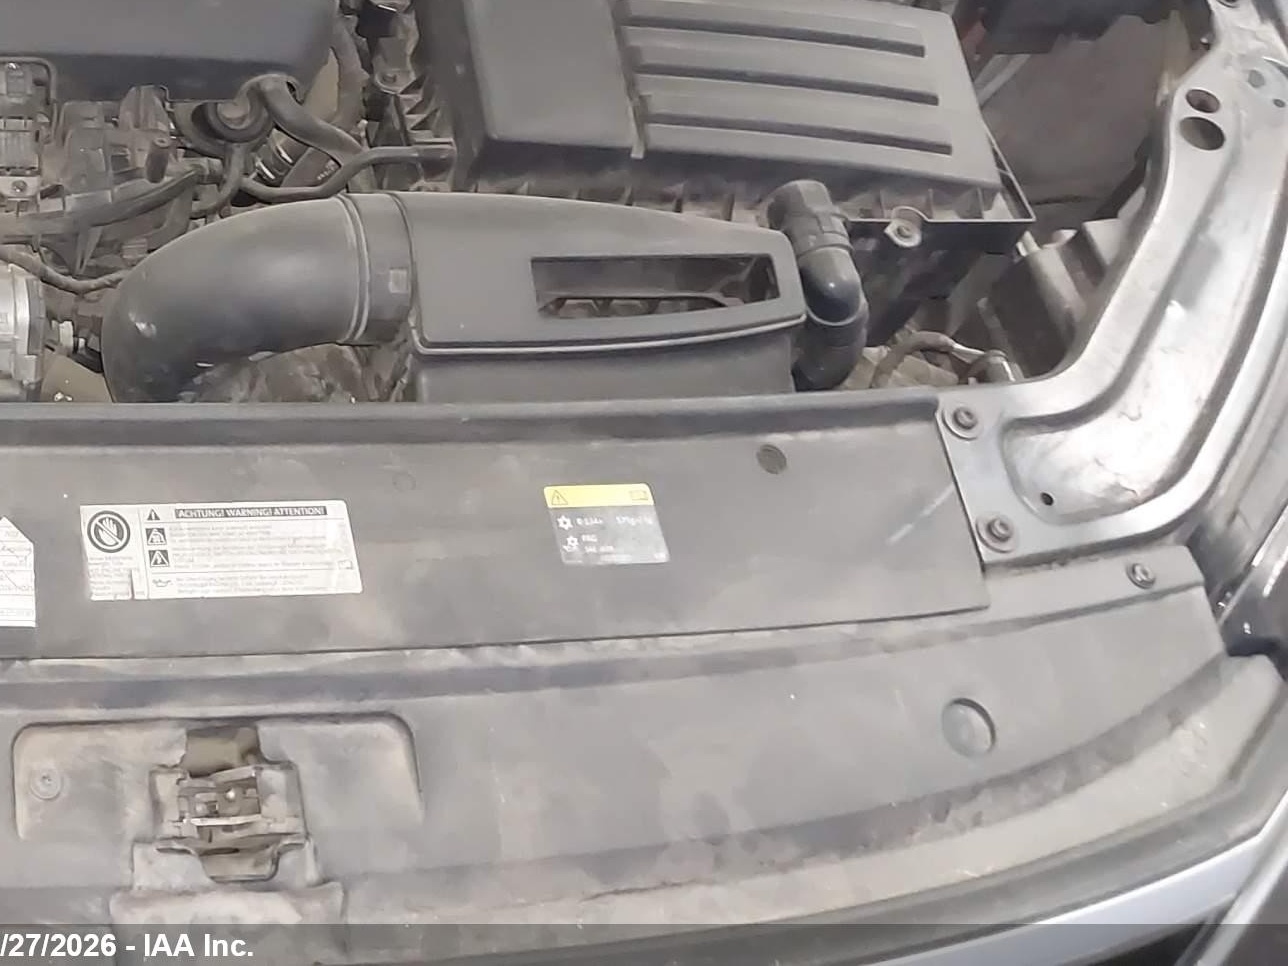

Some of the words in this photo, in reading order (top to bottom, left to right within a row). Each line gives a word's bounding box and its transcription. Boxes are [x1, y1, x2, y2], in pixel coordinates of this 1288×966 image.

[178, 508, 225, 518] ACHTUNG!
[226, 508, 272, 517] WARNING!
[274, 507, 325, 516] ATTENTION!
